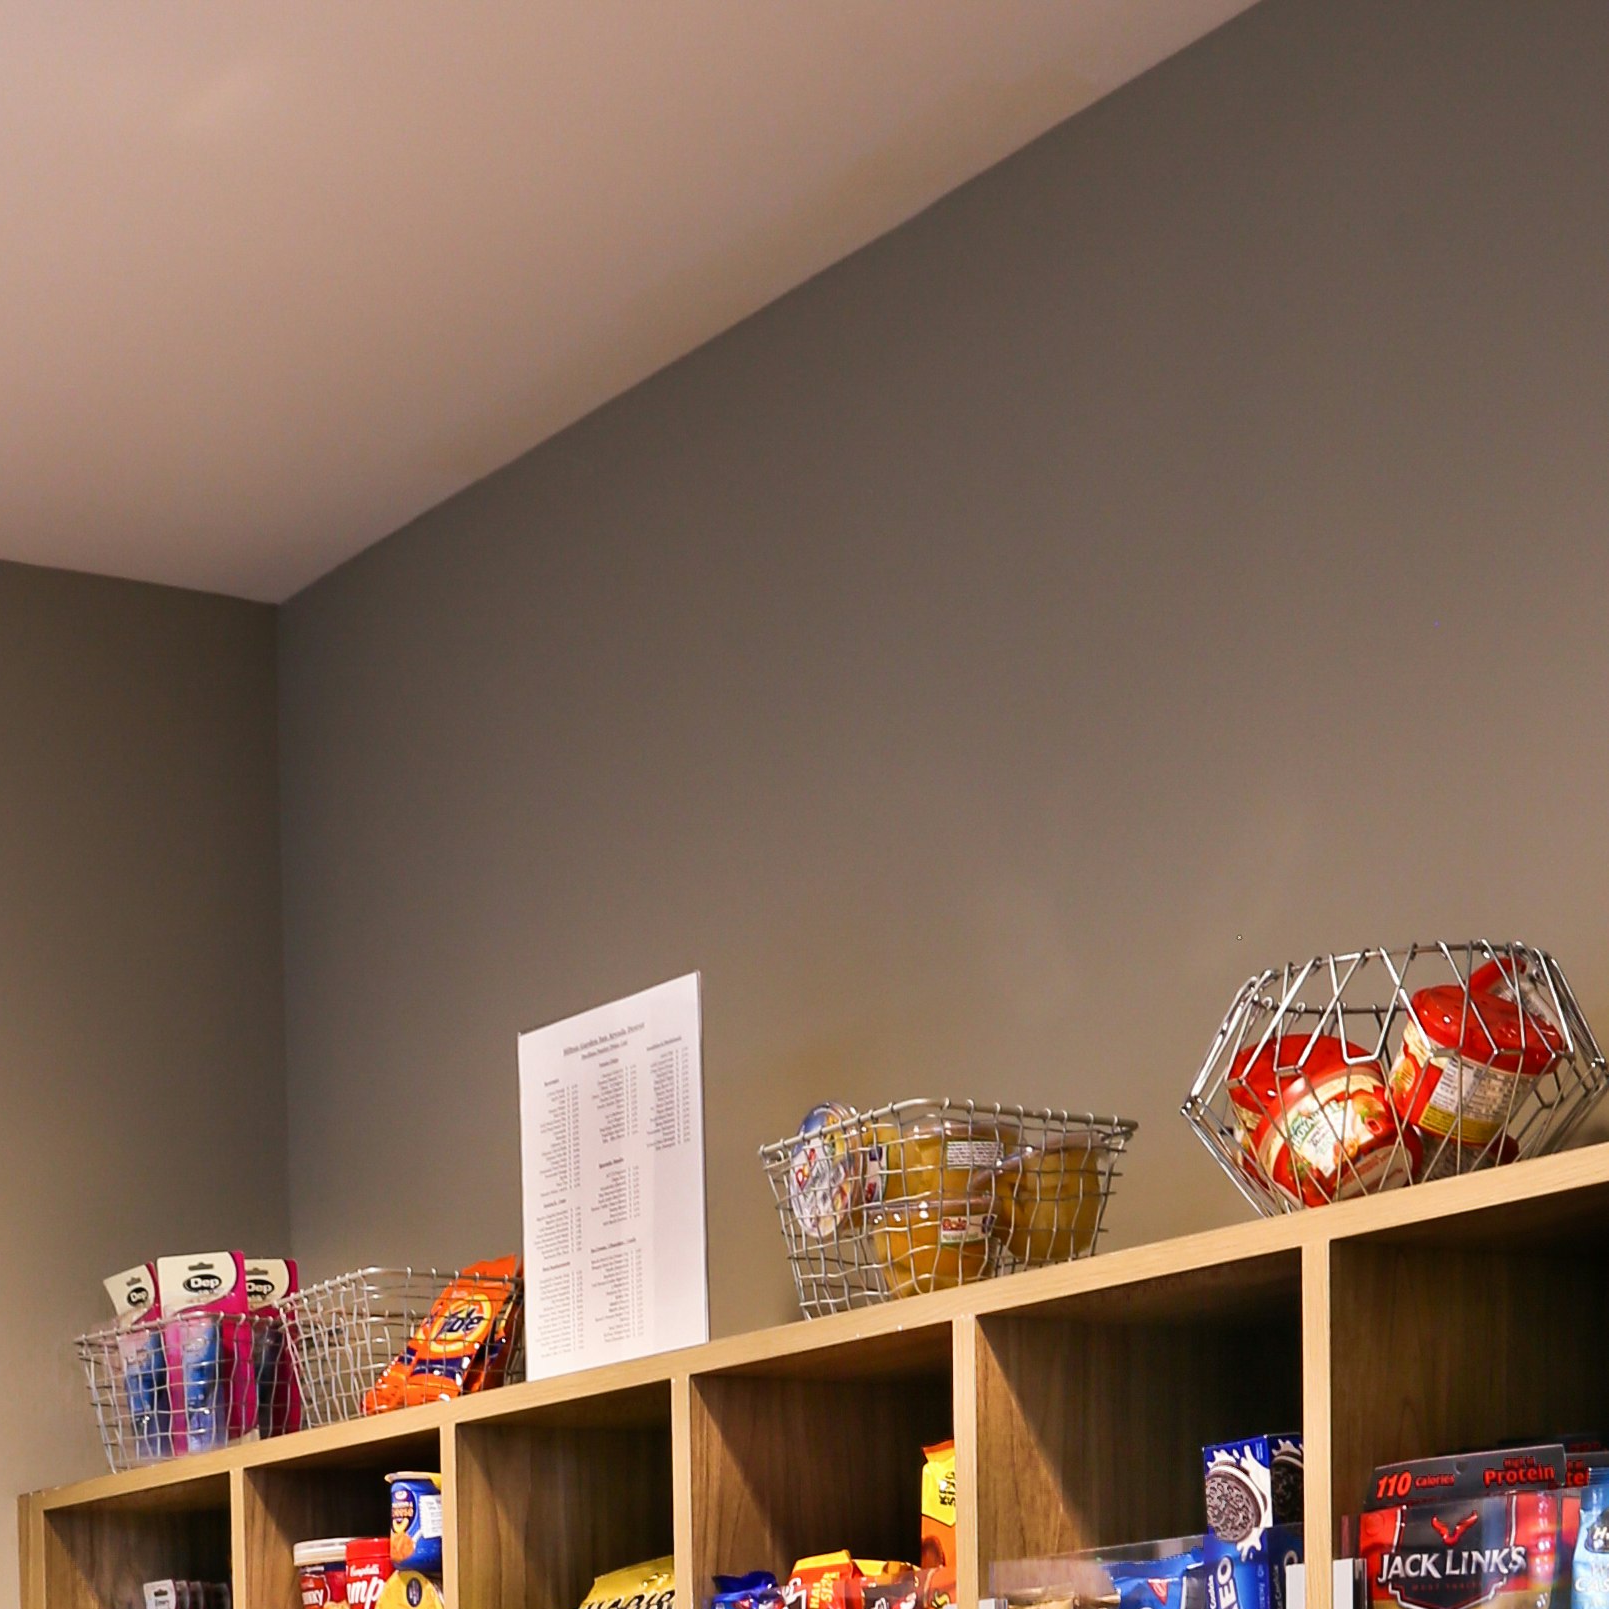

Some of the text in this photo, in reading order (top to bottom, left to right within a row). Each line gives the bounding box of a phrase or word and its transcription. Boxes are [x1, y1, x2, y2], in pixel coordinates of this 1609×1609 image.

[190, 1276, 220, 1290] Dep
[1377, 1471, 1412, 1499] 110
[1483, 1464, 1556, 1488] Protein
[1377, 1545, 1528, 1584] JACK LINK'S
